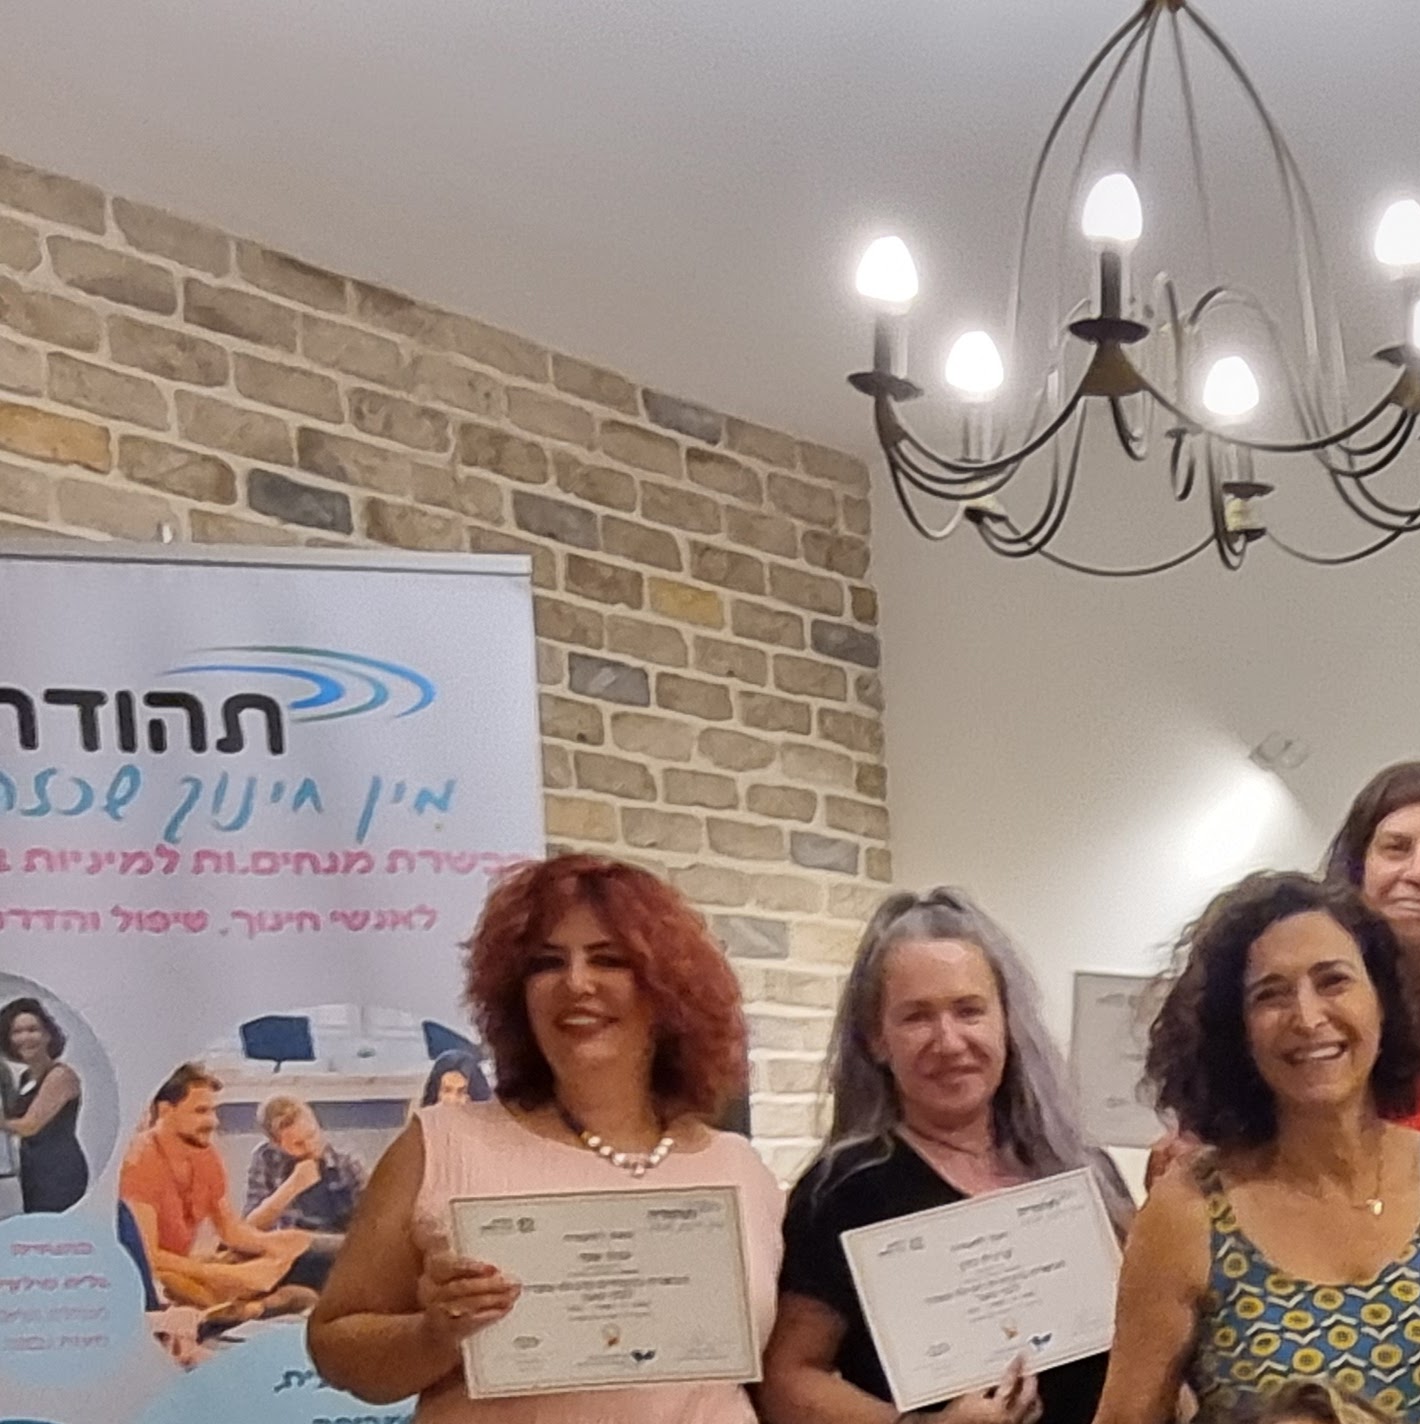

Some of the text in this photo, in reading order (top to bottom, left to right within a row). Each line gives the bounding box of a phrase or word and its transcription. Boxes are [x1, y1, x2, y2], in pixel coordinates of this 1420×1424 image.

[163, 771, 325, 845] חינוך
[356, 776, 458, 845] מין
[23, 843, 181, 876] למיניות
[111, 904, 208, 934] טיפול
[330, 904, 438, 933] לאנשי
